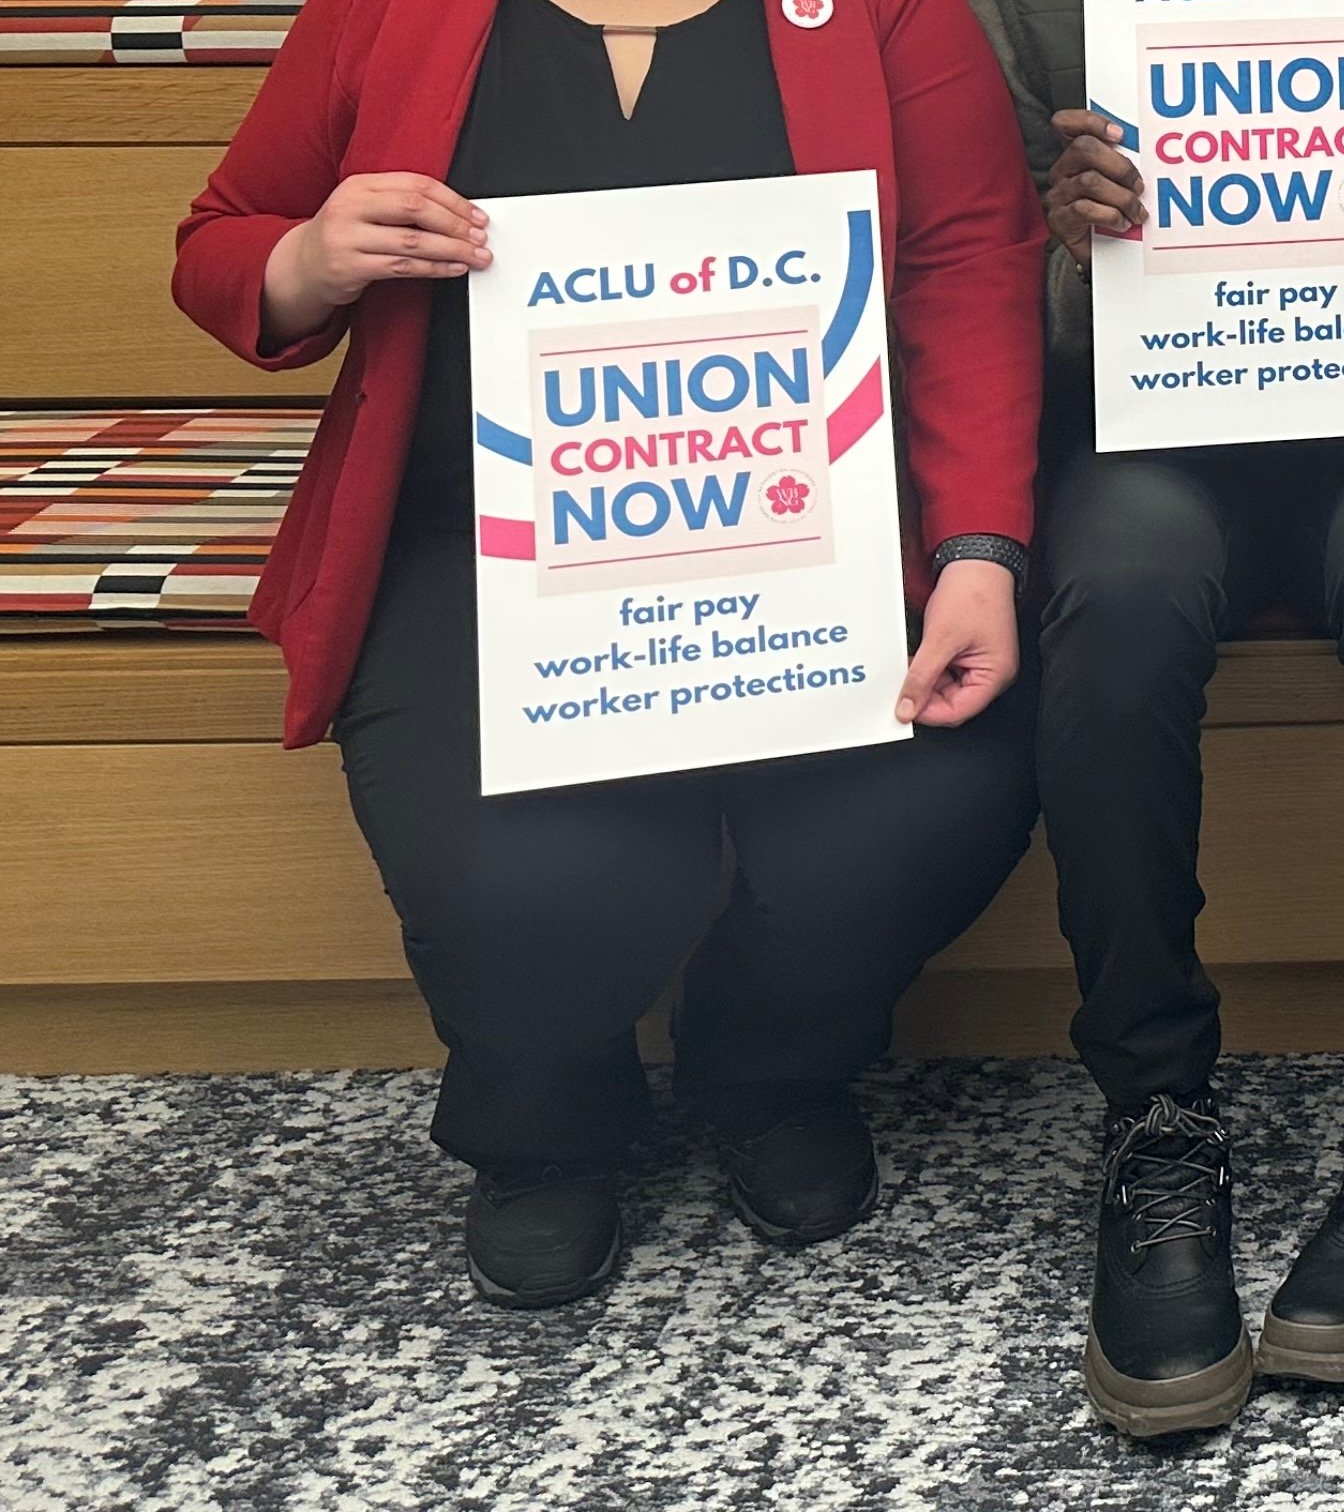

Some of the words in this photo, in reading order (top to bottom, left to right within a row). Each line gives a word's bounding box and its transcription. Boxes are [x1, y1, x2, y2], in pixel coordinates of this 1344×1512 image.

[1157, 170, 1333, 229] NOW
[528, 264, 655, 307] ACLU
[670, 257, 717, 295] of
[729, 251, 821, 290] D.C.
[1215, 281, 1271, 308] fair
[1280, 285, 1338, 312] pay
[1141, 318, 1286, 351] work-life
[545, 348, 810, 428] UNION
[1131, 361, 1249, 391] worker
[551, 420, 809, 477] CONTRACT
[553, 472, 751, 545] NOW
[620, 596, 684, 626] fair
[694, 594, 760, 626] pay
[535, 635, 702, 679] work-life
[712, 625, 848, 659] balance
[523, 687, 660, 724] worker
[671, 664, 866, 715] protections
